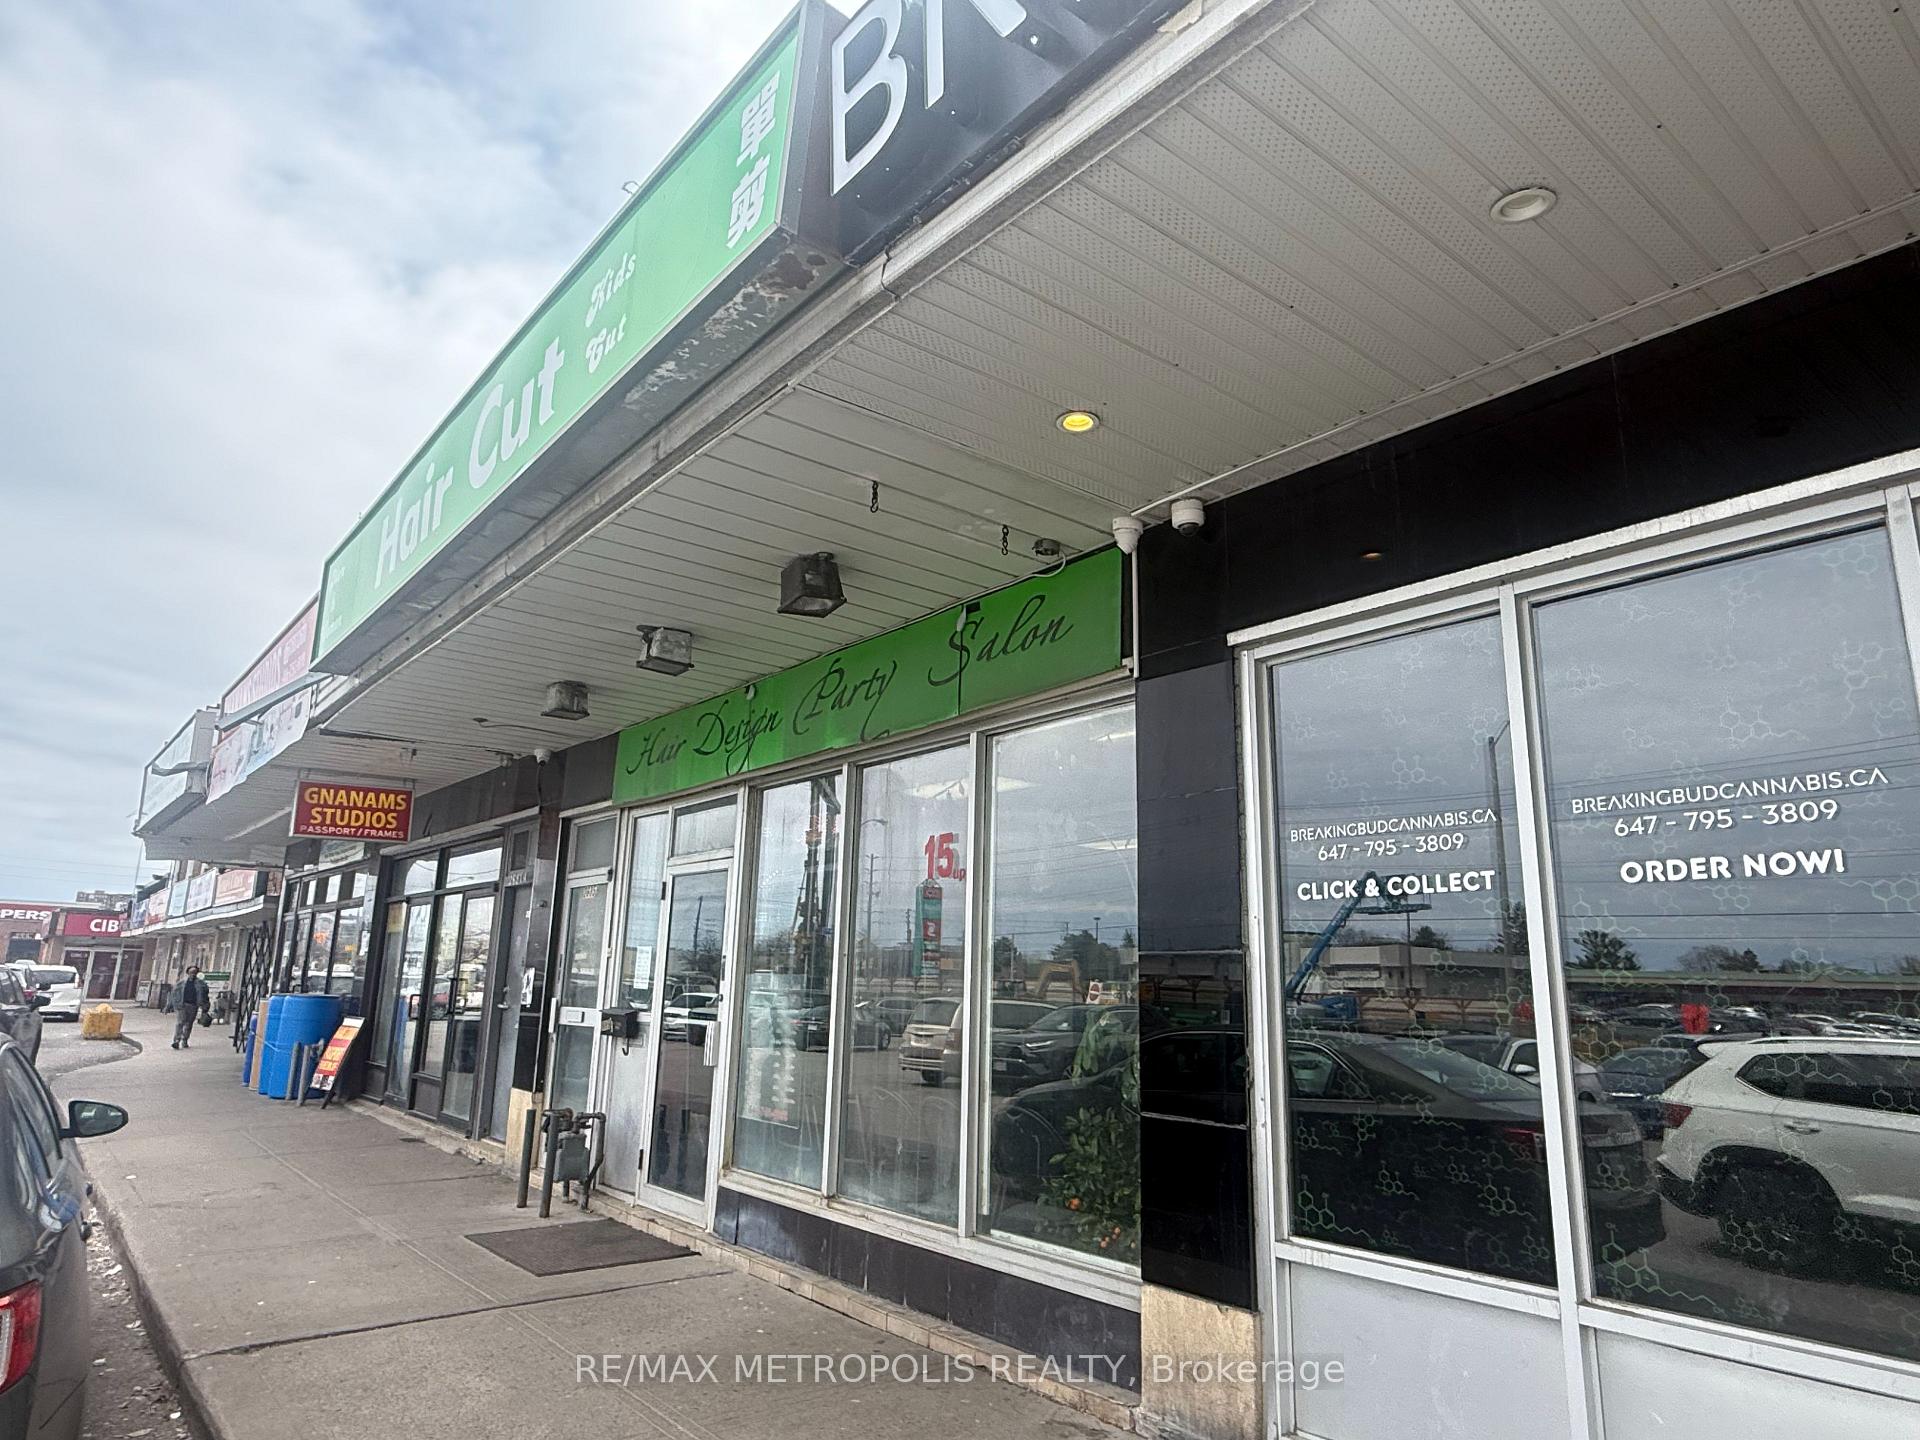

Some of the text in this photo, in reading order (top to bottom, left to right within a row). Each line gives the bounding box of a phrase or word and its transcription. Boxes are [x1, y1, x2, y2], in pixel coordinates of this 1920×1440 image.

[585, 252, 636, 328] Kids
[585, 313, 627, 374] Cut
[374, 335, 565, 590] Hair Cut
[626, 594, 1074, 777] Hair Design Party Salon
[304, 787, 407, 811] GNANAMS
[1571, 767, 1889, 814] BREAKINGBUDCANNABIS.CA
[310, 807, 398, 829] STUDIOS
[1290, 808, 1497, 842] BREAKINGBUDCANNABIS.CA
[1614, 815, 1658, 838] 647
[1683, 808, 1734, 831] 795
[1762, 799, 1839, 825] 3809
[925, 832, 954, 879] 15
[1318, 843, 1348, 861] 647
[1364, 838, 1397, 857] 795
[1415, 832, 1465, 853] 3809
[1619, 848, 1846, 884] ORDER NOW!
[1297, 870, 1496, 901] CLICK & COLLECT
[0, 909, 52, 920] PERS
[90, 918, 120, 932] CIB
